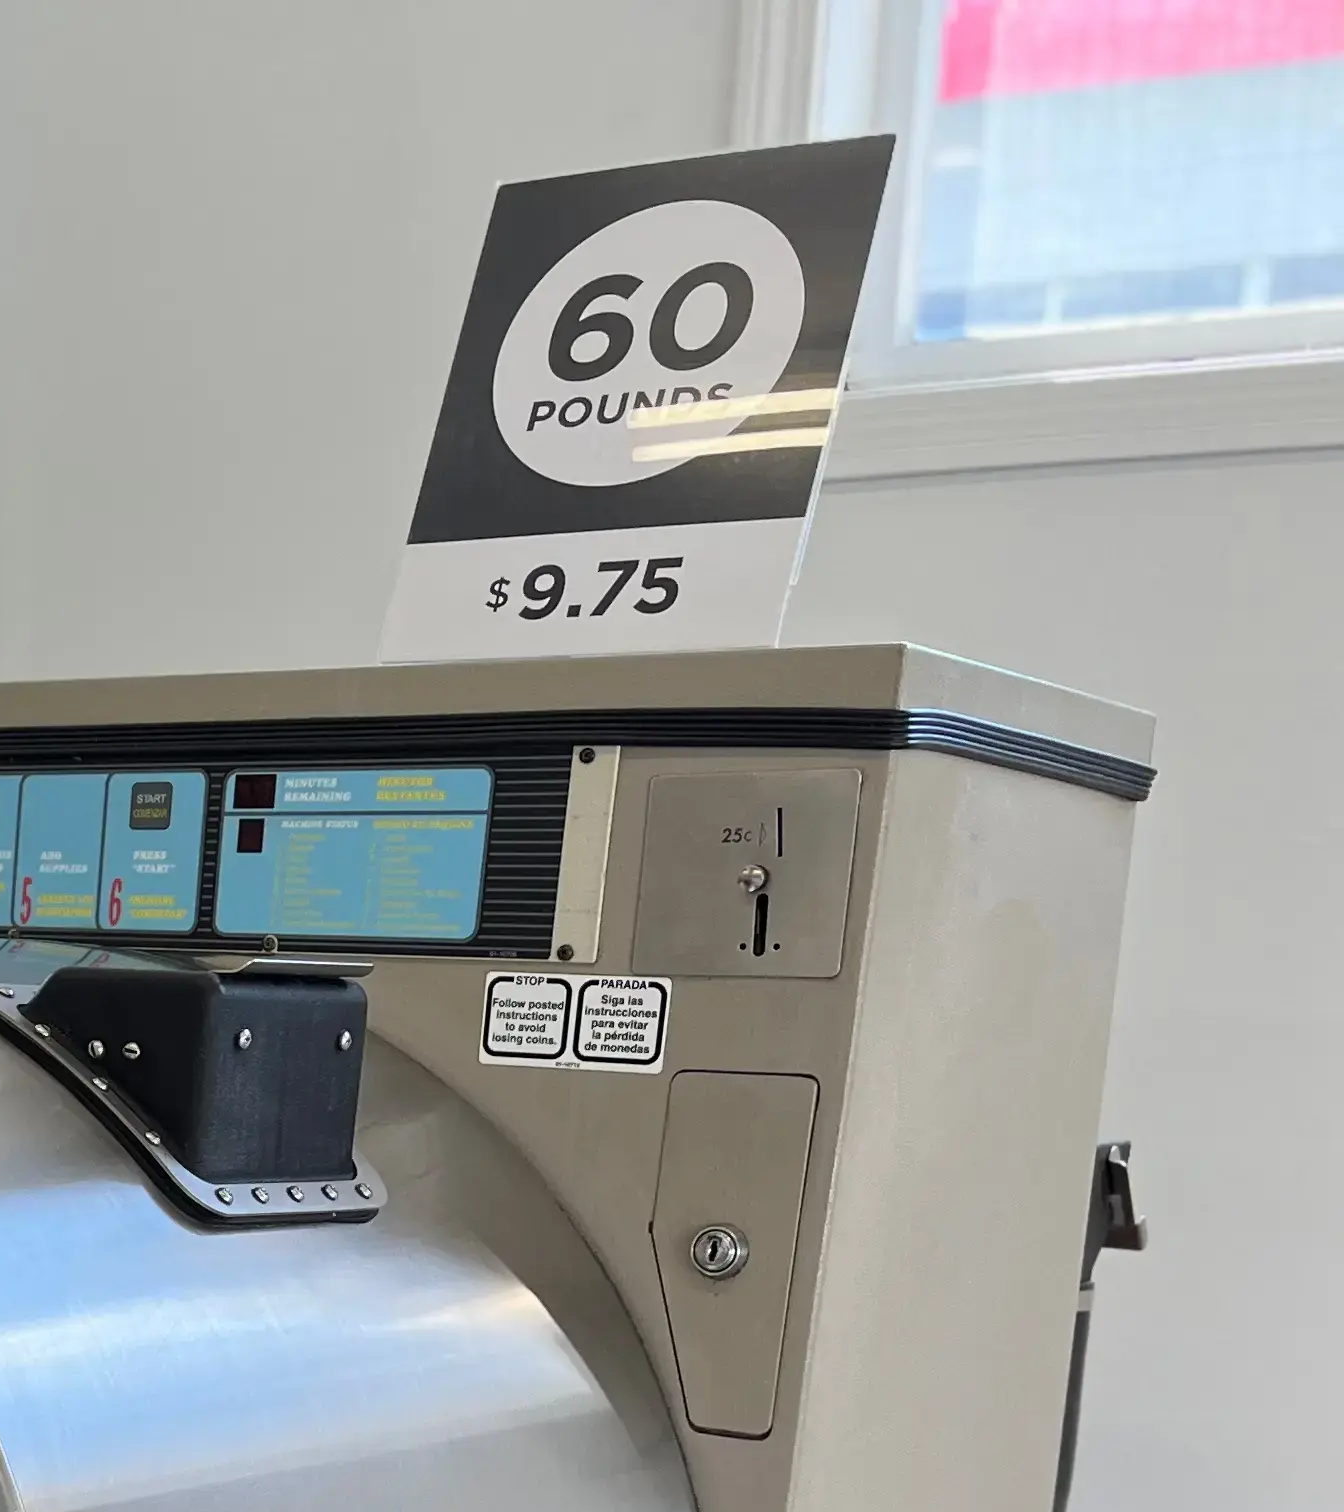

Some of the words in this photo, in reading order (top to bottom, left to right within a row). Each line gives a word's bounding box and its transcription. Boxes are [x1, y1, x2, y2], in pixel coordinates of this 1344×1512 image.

[548, 261, 754, 381] 60
[486, 557, 683, 620] $9.75
[284, 778, 338, 788] MINUTES
[137, 794, 166, 804] START
[284, 791, 351, 802] REMAINING
[20, 877, 32, 925] 5
[109, 878, 122, 927] 6
[516, 976, 545, 986] STOP
[601, 979, 647, 990] PARADA
[493, 998, 526, 1008] Follow
[528, 1001, 563, 1011] posted
[601, 995, 624, 1006] Siga
[628, 995, 643, 1005] las
[496, 1011, 557, 1021] instructions
[585, 1007, 657, 1018] instrucciones
[505, 1022, 515, 1031] to
[518, 1023, 546, 1032] avoid
[591, 1020, 614, 1030] para
[618, 1019, 648, 1029] evitar
[492, 1033, 522, 1045] losing
[592, 1030, 601, 1039] la
[604, 1030, 645, 1042] pérdida
[584, 1042, 597, 1051] de
[600, 1043, 650, 1054] monedas
